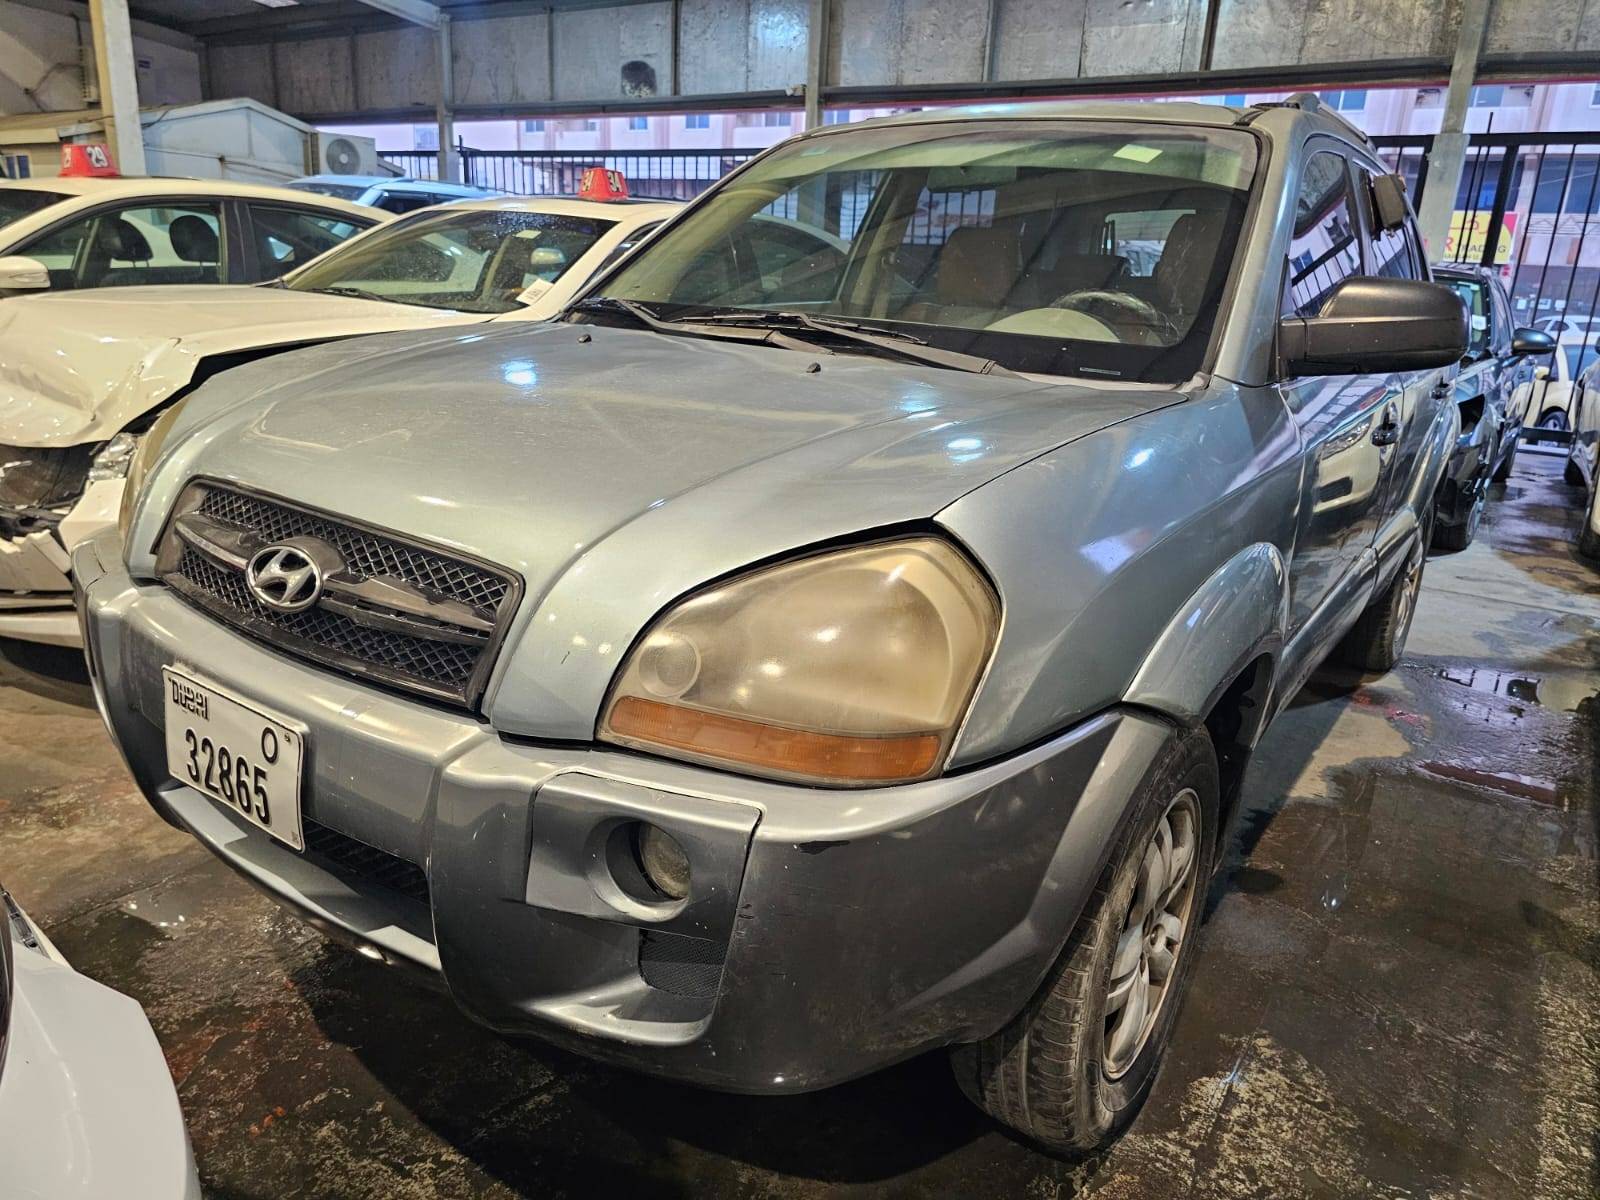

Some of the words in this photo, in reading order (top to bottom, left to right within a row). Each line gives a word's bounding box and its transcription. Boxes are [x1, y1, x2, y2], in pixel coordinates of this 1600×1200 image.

[86, 146, 108, 168] 29
[607, 170, 622, 192] 34
[185, 729, 270, 825] 32865
